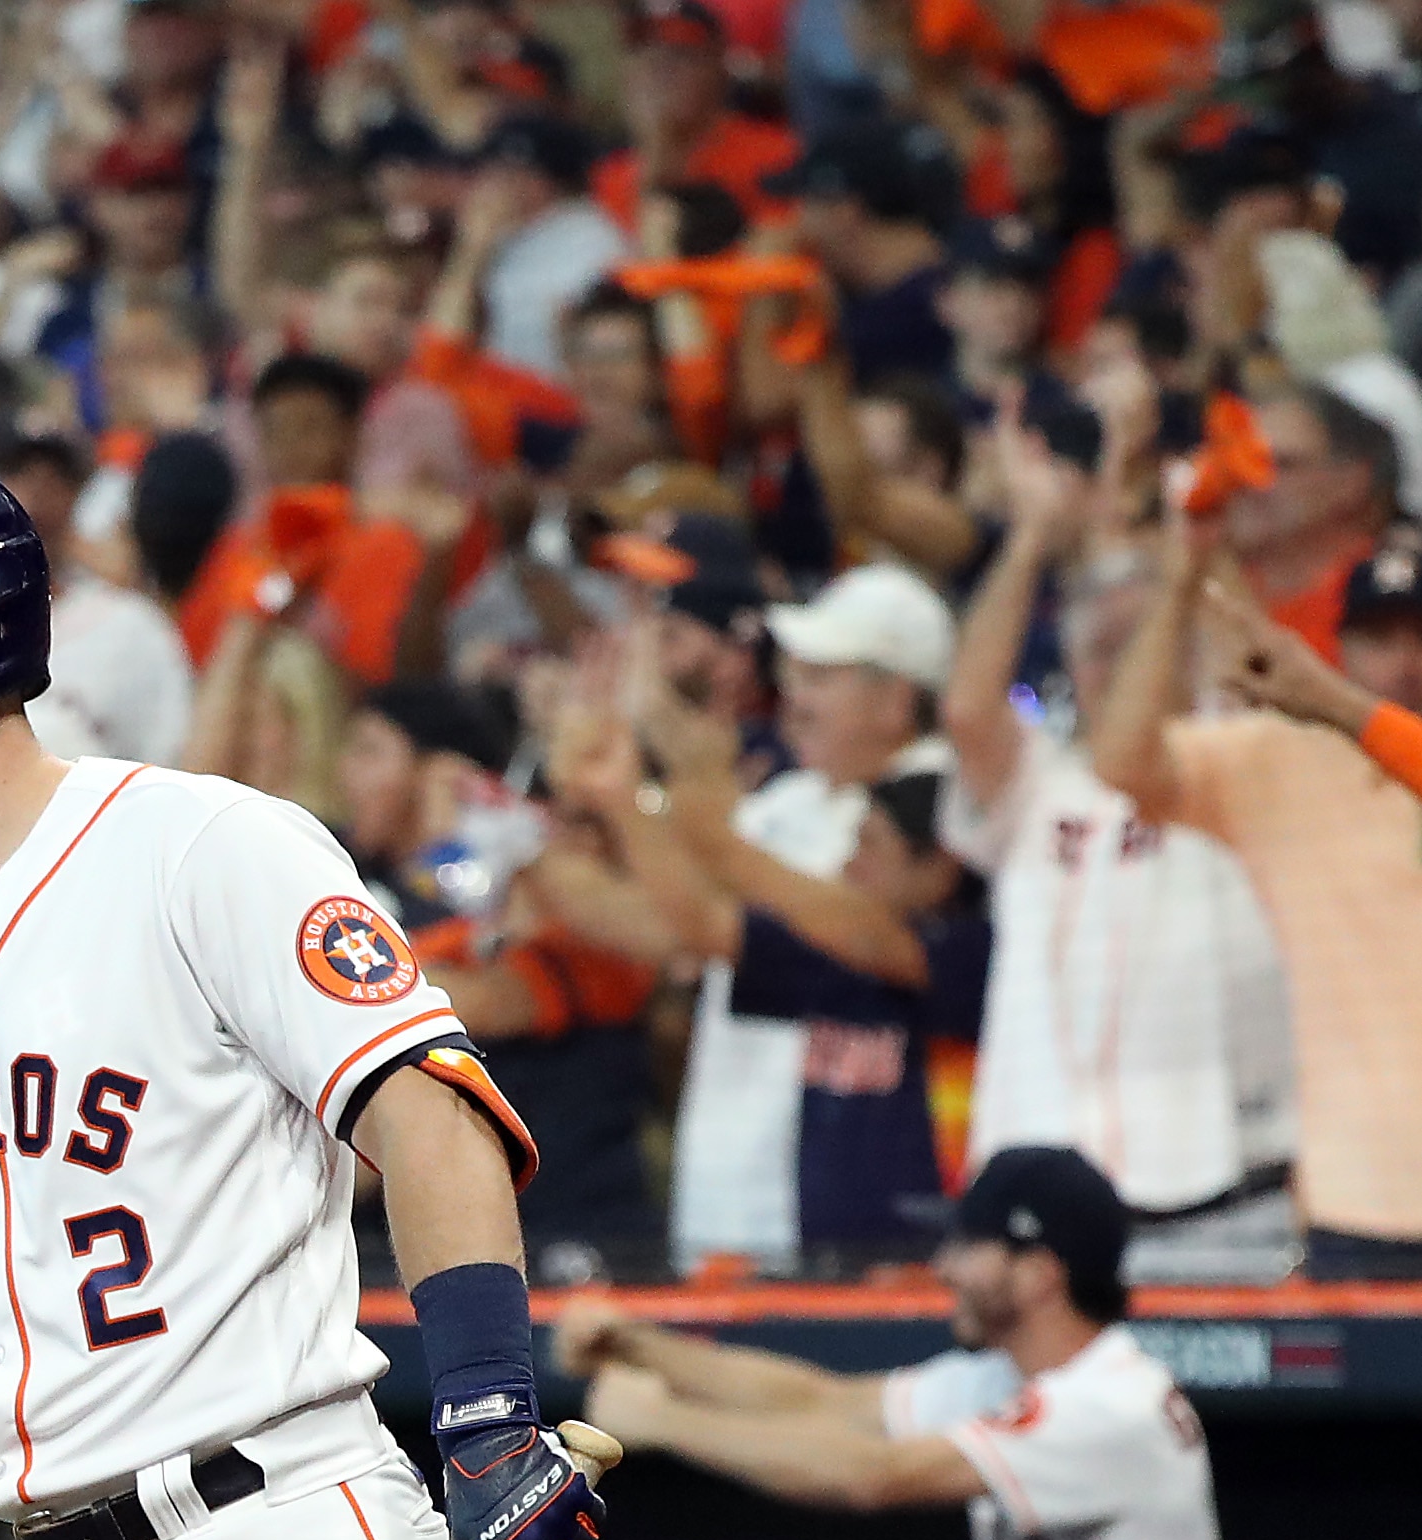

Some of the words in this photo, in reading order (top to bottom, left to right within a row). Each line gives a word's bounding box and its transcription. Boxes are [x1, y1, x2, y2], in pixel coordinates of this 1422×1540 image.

[304, 901, 375, 951] HOUSTON
[349, 960, 415, 1000] ASTROS
[63, 1205, 169, 1351] 2
